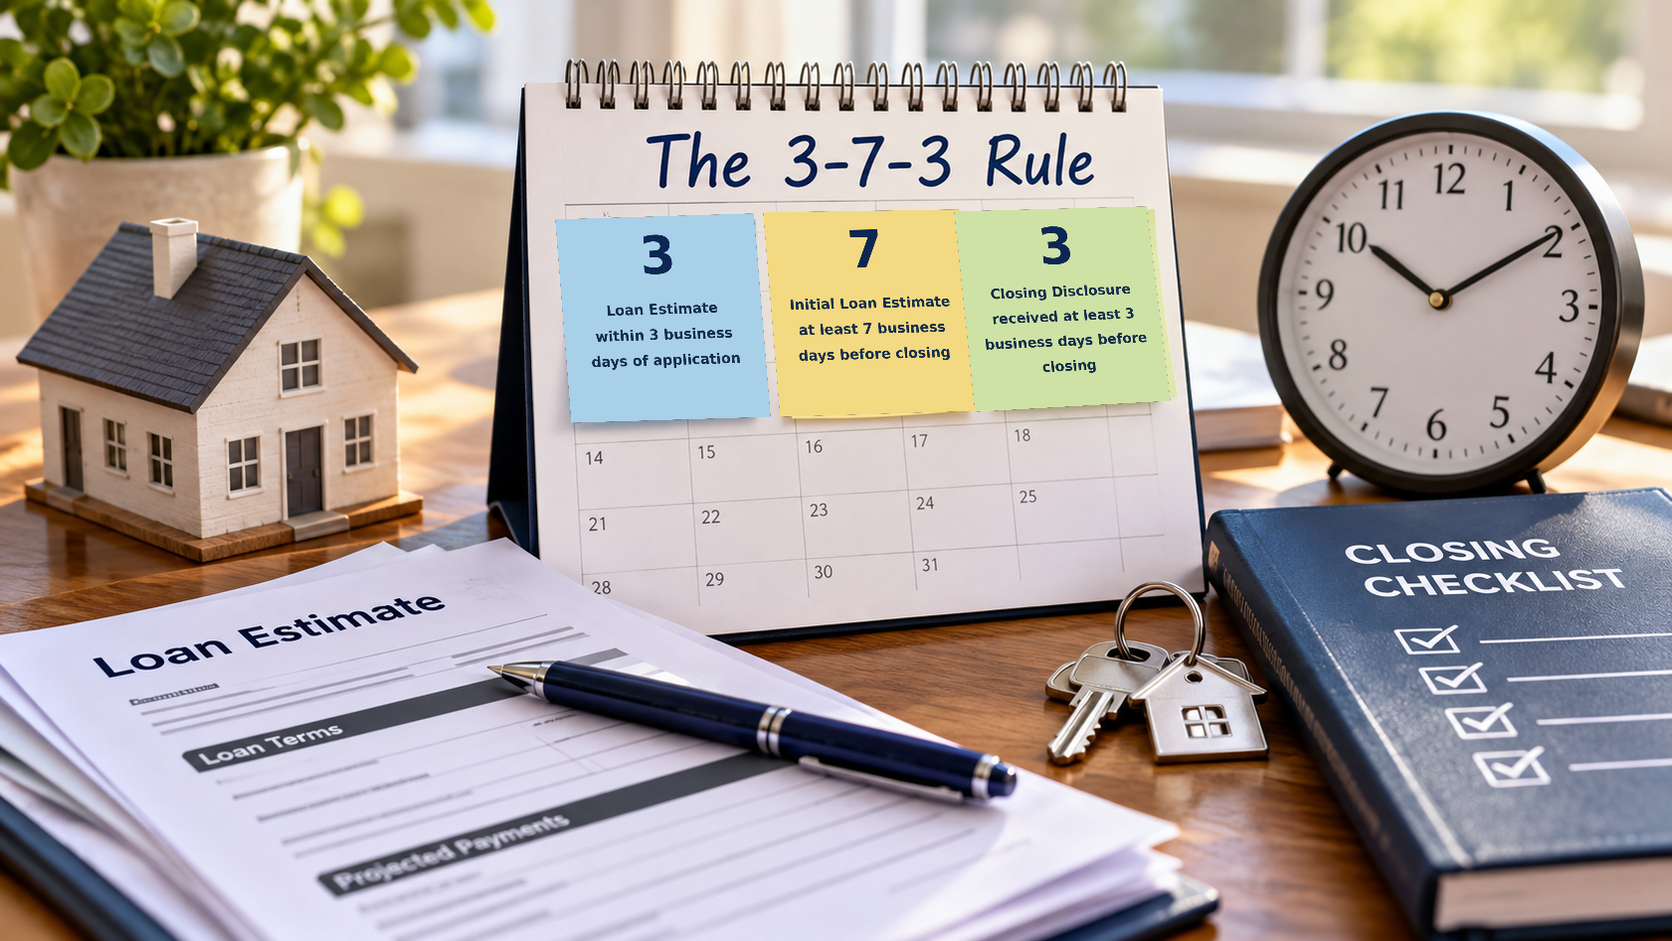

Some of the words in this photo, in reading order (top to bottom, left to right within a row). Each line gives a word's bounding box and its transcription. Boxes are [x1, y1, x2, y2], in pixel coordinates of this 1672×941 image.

[647, 131, 750, 188] The
[785, 135, 950, 187] 3-7-3
[987, 133, 1094, 186] Rule
[1435, 163, 1465, 194] 12
[1380, 180, 1403, 209] 11
[1504, 181, 1512, 211] 1
[849, 229, 878, 267] 7
[1041, 226, 1070, 264] 3
[1338, 223, 1366, 252] 10
[1543, 225, 1563, 258] 2
[644, 235, 672, 274] 3
[790, 297, 835, 311] Initial
[839, 298, 877, 310] Loan
[882, 296, 950, 309] Estimate
[990, 287, 1047, 301] Closing
[1051, 284, 1131, 298] Disclosure
[1316, 280, 1334, 309] 9
[1559, 290, 1579, 322] 3
[606, 305, 644, 317] Loan
[649, 302, 718, 316] Estimate
[992, 310, 1058, 325] received
[1063, 310, 1079, 322] at
[1083, 309, 1121, 321] least
[1125, 307, 1135, 320] 3
[595, 329, 644, 343] within
[649, 328, 659, 341] 3
[663, 327, 733, 341] business
[799, 324, 815, 336] at
[820, 323, 859, 336] least
[862, 322, 872, 335] 7
[877, 321, 946, 334] business
[985, 337, 1053, 351] business
[1057, 335, 1093, 349] days
[1097, 332, 1147, 345] before
[591, 355, 628, 371] days
[633, 354, 649, 367] of
[653, 352, 741, 369] application
[798, 349, 835, 365] days
[840, 347, 891, 361] before
[895, 346, 951, 361] closing
[1042, 359, 1097, 374] closing
[1329, 340, 1347, 370] 8
[1535, 352, 1557, 383] 4
[1371, 387, 1388, 417] 7
[1490, 396, 1509, 428] 5
[1427, 409, 1446, 440] 6
[586, 450, 604, 465] 14
[698, 444, 716, 460] 15
[805, 439, 823, 454] 16
[911, 433, 928, 448] 17
[1014, 428, 1031, 442] 18
[588, 516, 606, 532] 21
[701, 509, 721, 525] 22
[810, 502, 828, 518] 23
[916, 496, 935, 511] 24
[1019, 489, 1037, 504] 25
[1346, 539, 1560, 564] CLOSING
[591, 580, 612, 595] 28
[705, 572, 724, 587] 29
[814, 564, 833, 580] 30
[922, 557, 938, 572] 31
[1365, 568, 1625, 596] CHECKLIST
[93, 641, 232, 677] Loan
[238, 597, 445, 648] Estimate
[197, 740, 267, 768] Loan
[264, 722, 345, 752] Terms
[332, 844, 456, 891] Projected
[453, 812, 571, 856] Payments
